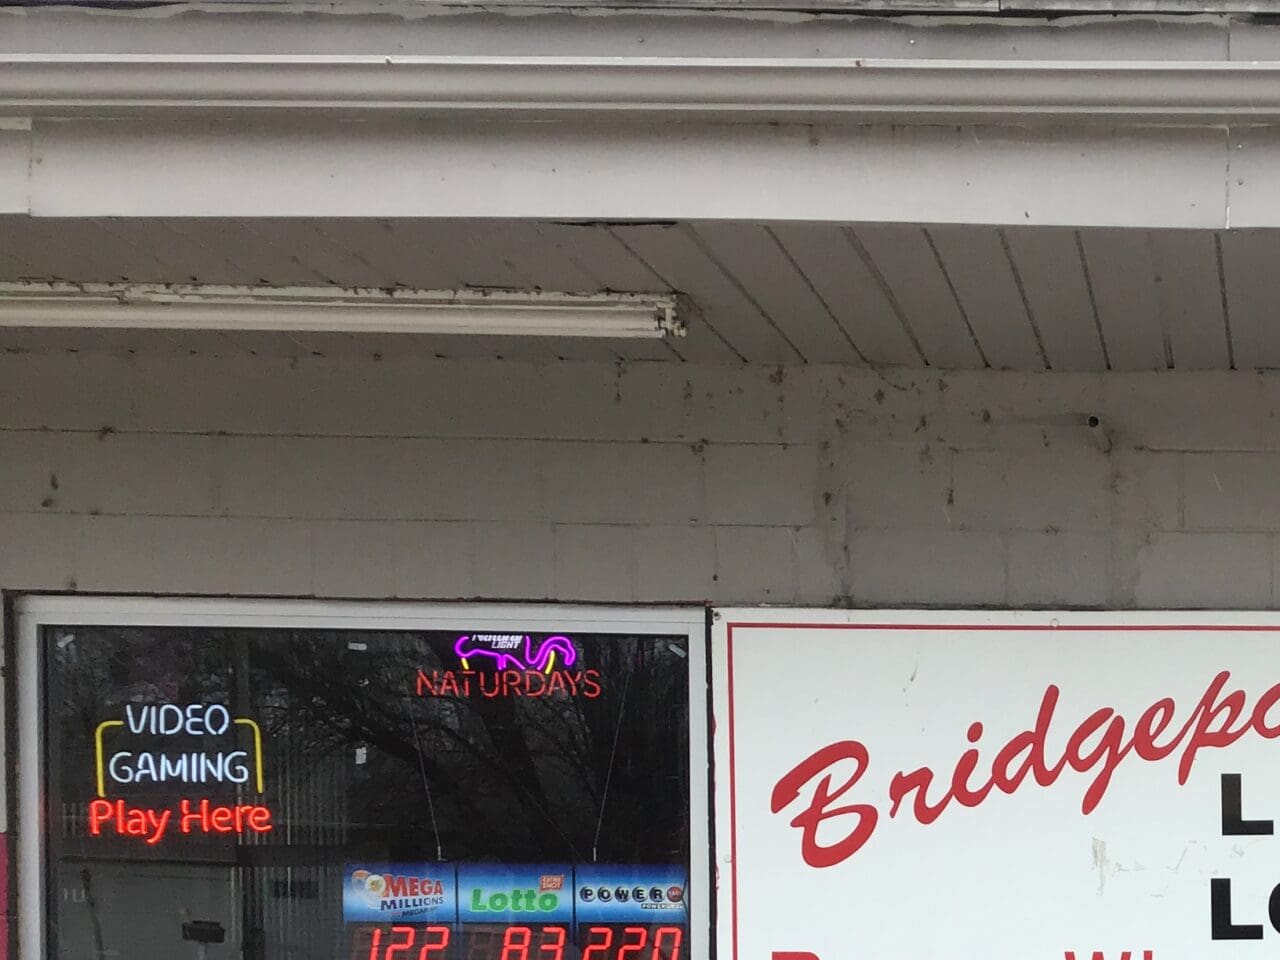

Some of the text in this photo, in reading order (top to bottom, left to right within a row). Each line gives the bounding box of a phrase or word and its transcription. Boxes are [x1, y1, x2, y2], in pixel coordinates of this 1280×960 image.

[415, 669, 602, 698] NATURDAYS
[125, 704, 230, 735] VIDEO
[109, 751, 249, 784] GAMING
[89, 799, 272, 844] Play Here
[383, 874, 443, 897] MEGA
[471, 889, 558, 911] Lotto
[380, 897, 444, 911] MILLIONS
